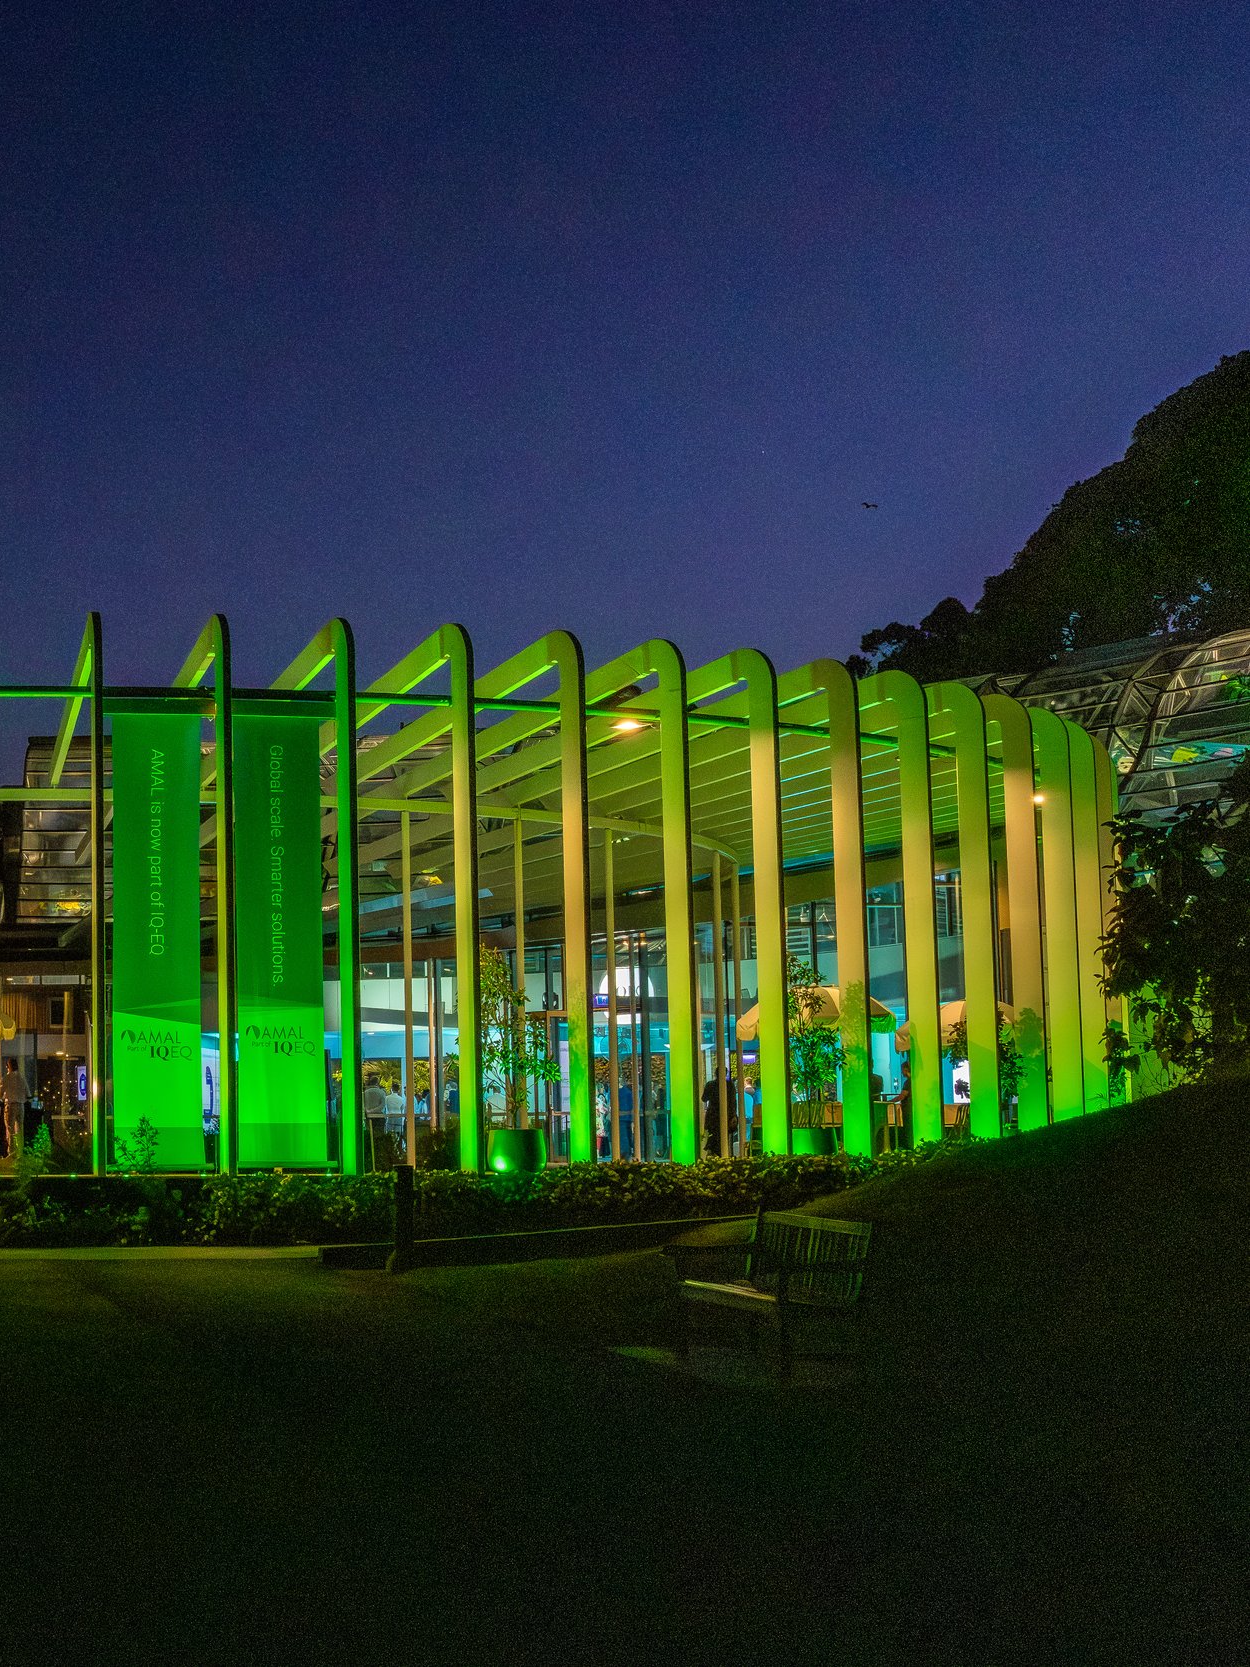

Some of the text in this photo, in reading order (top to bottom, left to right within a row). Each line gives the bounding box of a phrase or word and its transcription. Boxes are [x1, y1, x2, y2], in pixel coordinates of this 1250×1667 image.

[147, 749, 165, 956] AMAL is now part of IQ-EQ
[270, 744, 286, 987] Global scale. Smarter solutions.
[137, 1031, 181, 1043] AMAL
[262, 1026, 303, 1039] AMAL
